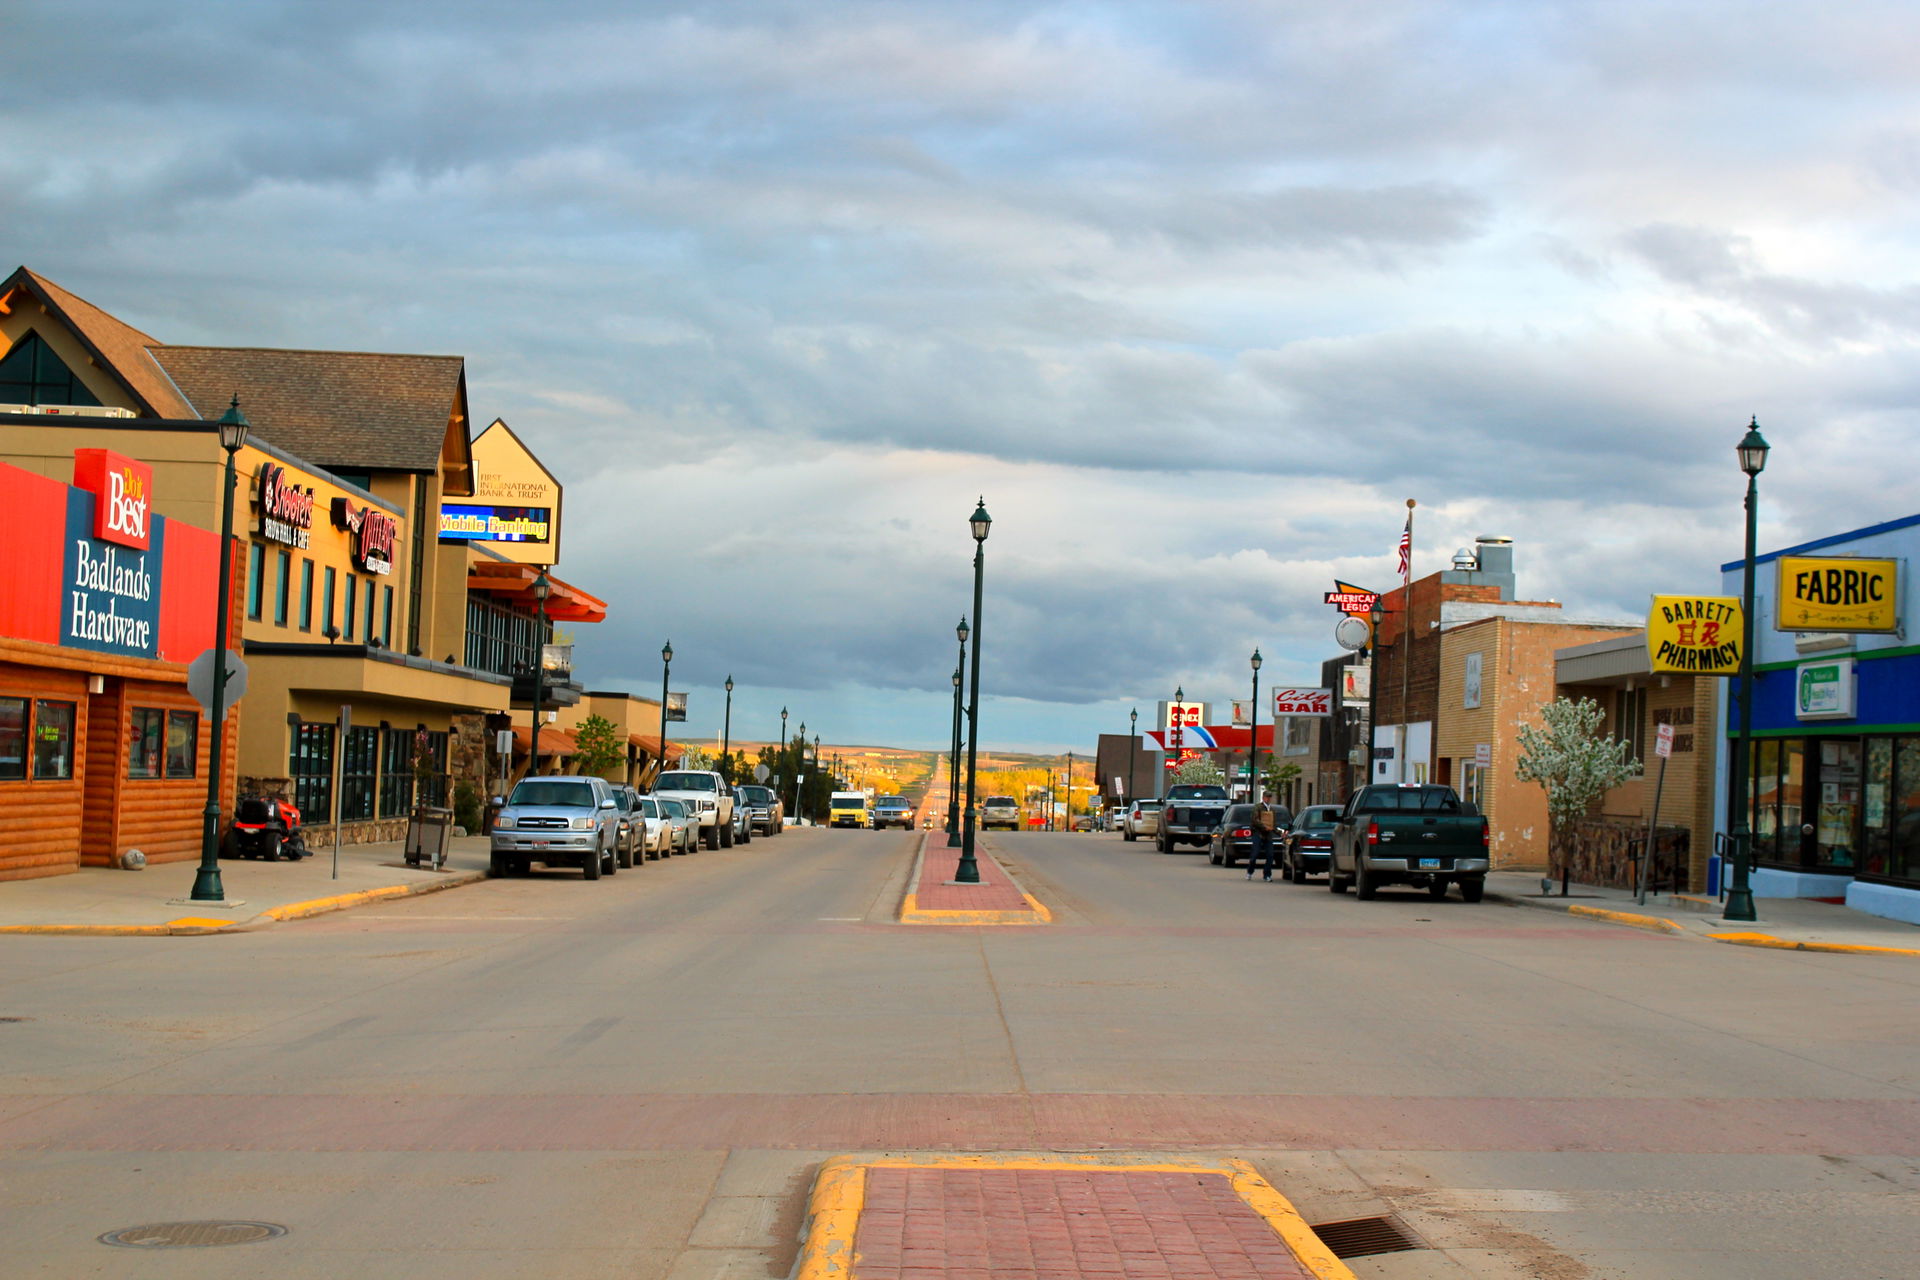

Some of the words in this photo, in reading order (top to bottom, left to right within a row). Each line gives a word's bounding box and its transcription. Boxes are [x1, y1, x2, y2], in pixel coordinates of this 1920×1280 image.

[480, 481, 549, 491] INTRNATIONAL
[480, 489, 504, 497] BANK
[108, 471, 147, 539] Best
[441, 515, 486, 532] Mobile
[488, 517, 547, 540] Banking
[75, 540, 151, 602] Badlands
[1796, 569, 1883, 605] FABRIC
[1341, 603, 1373, 612] LEGIO
[1662, 601, 1735, 624] BARRETT
[71, 591, 150, 650] Hardware
[1656, 640, 1740, 670] PHARMACY
[1276, 689, 1330, 705] City
[1278, 703, 1328, 713] BAR
